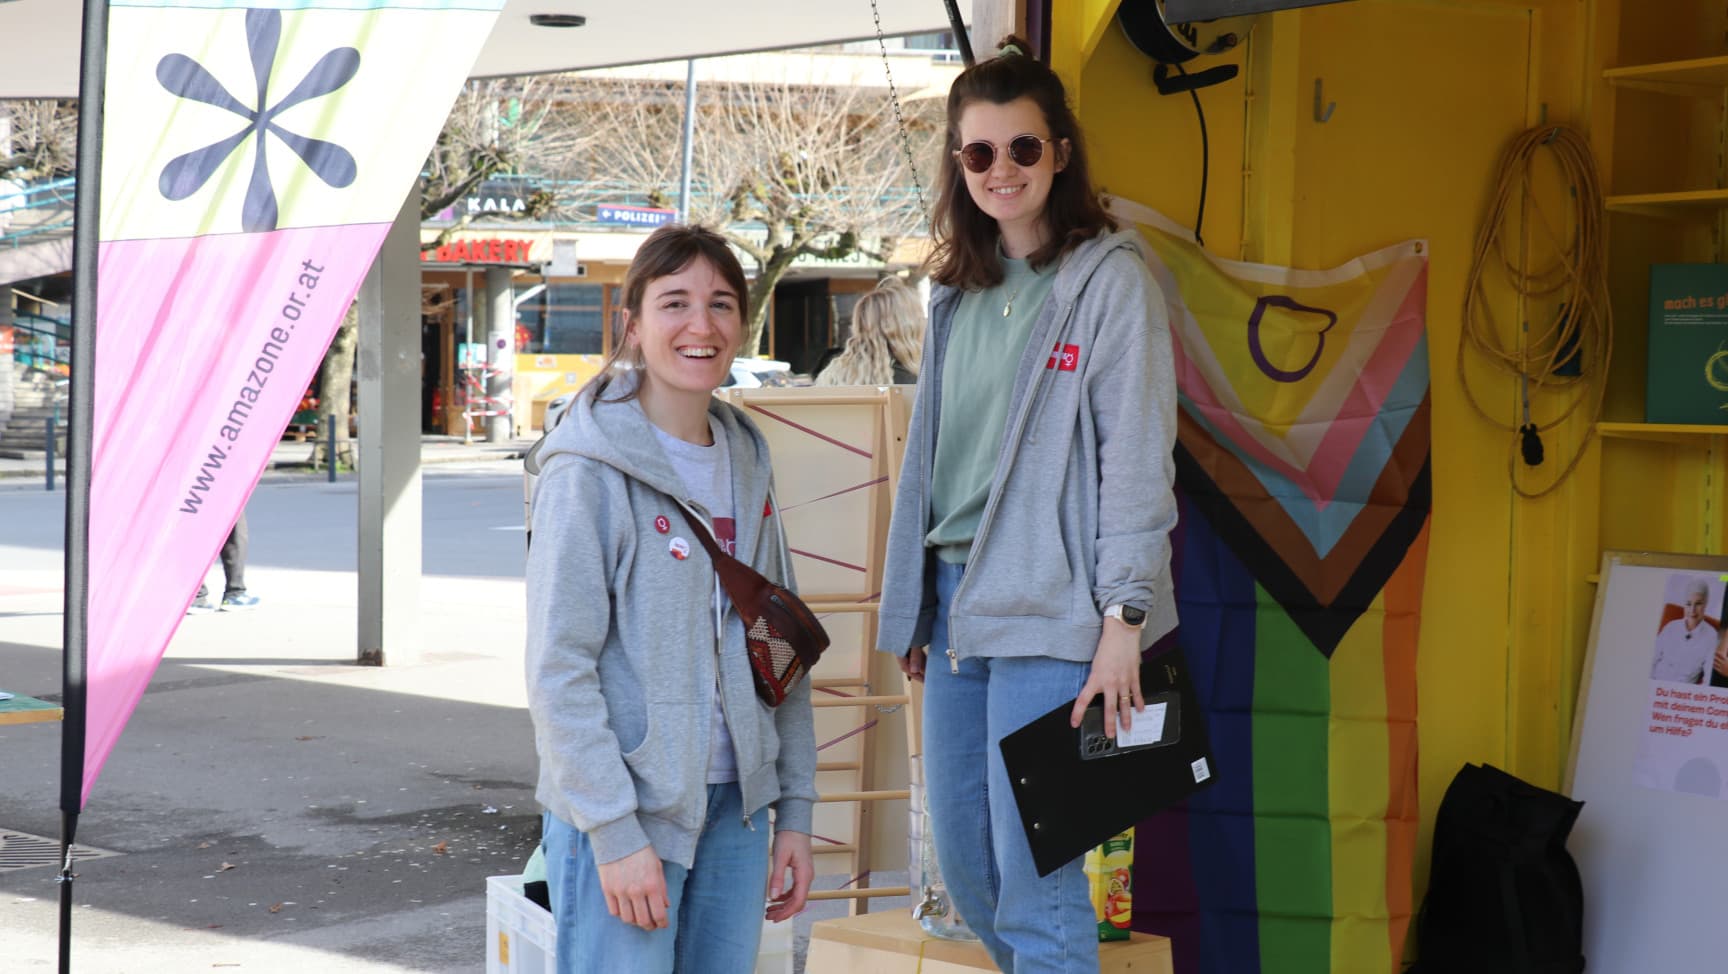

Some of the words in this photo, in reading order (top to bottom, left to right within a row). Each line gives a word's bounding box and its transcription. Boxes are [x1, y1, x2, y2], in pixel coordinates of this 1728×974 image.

[467, 197, 526, 212] KALA
[614, 210, 660, 224] POLIZEI
[437, 239, 535, 263] BAKERY
[1664, 296, 1697, 310] mach
[180, 258, 325, 515] www.amazone.or.at
[1656, 687, 1668, 696] Du
[1671, 689, 1692, 700] hast
[1694, 692, 1708, 701] ein
[1653, 701, 1668, 709] mit
[1671, 703, 1704, 713] deinem
[1652, 712, 1672, 721] Wen
[1705, 719, 1718, 728] du
